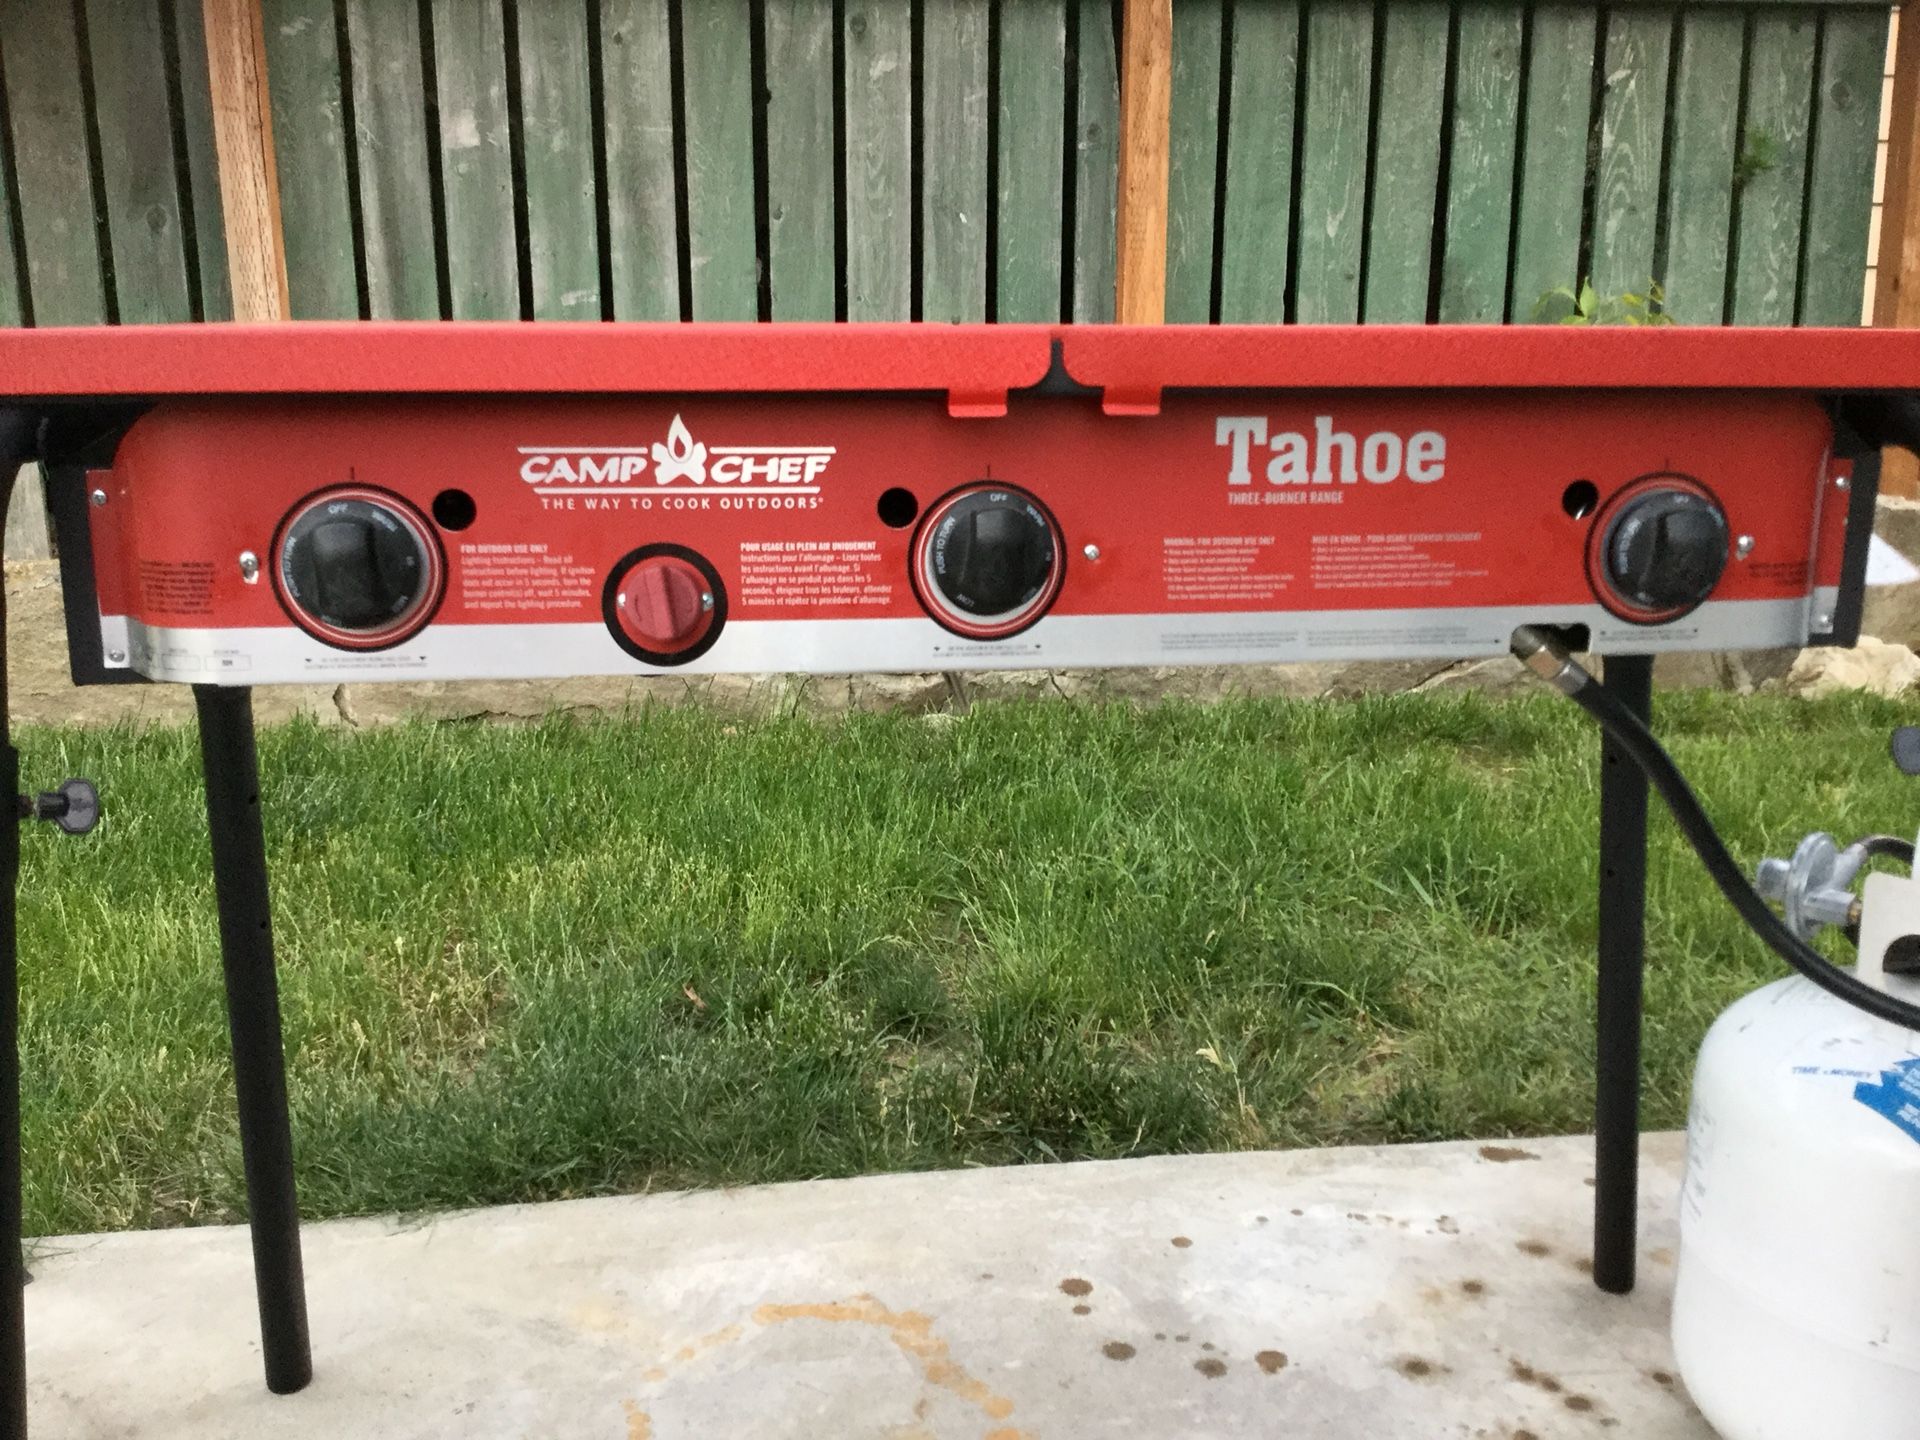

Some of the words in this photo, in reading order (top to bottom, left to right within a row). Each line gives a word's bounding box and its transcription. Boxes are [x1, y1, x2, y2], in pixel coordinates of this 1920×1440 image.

[1216, 416, 1446, 485] Tahoe
[520, 456, 647, 484] CAMP
[710, 455, 831, 484] CHEF
[989, 493, 1009, 504] OFF
[1228, 491, 1307, 505] THREE-BURNER
[1309, 490, 1344, 505] RANGE
[541, 497, 576, 511] THE
[584, 497, 622, 511] WAY
[631, 497, 653, 510] TO
[662, 497, 711, 510] COOK
[939, 516, 956, 538] TURN
[460, 544, 476, 554] FOR
[478, 544, 512, 554] OUTDOOR
[514, 544, 528, 553] USE
[529, 544, 548, 554] ONLY
[740, 543, 760, 552] POUR
[761, 542, 784, 552] USAGE
[786, 542, 796, 552] EN
[796, 542, 818, 552] PLEIN
[818, 542, 830, 552] AIR
[832, 542, 876, 551] UNIQUEMENT
[936, 538, 946, 550] TO
[740, 554, 781, 563] Instructions
[782, 555, 798, 564] pour
[860, 553, 882, 562] toutes
[936, 550, 946, 574] PUSH
[741, 565, 752, 574] les
[752, 564, 792, 574] instructions
[794, 564, 814, 574] avant
[798, 574, 822, 584] produit
[823, 576, 836, 584] pas
[836, 574, 854, 583] dans
[855, 574, 866, 583] les
[804, 586, 820, 594] tous
[821, 586, 832, 594] les
[748, 597, 776, 606] minutes
[776, 596, 784, 605] et
[1792, 1066, 1820, 1075] TIME
